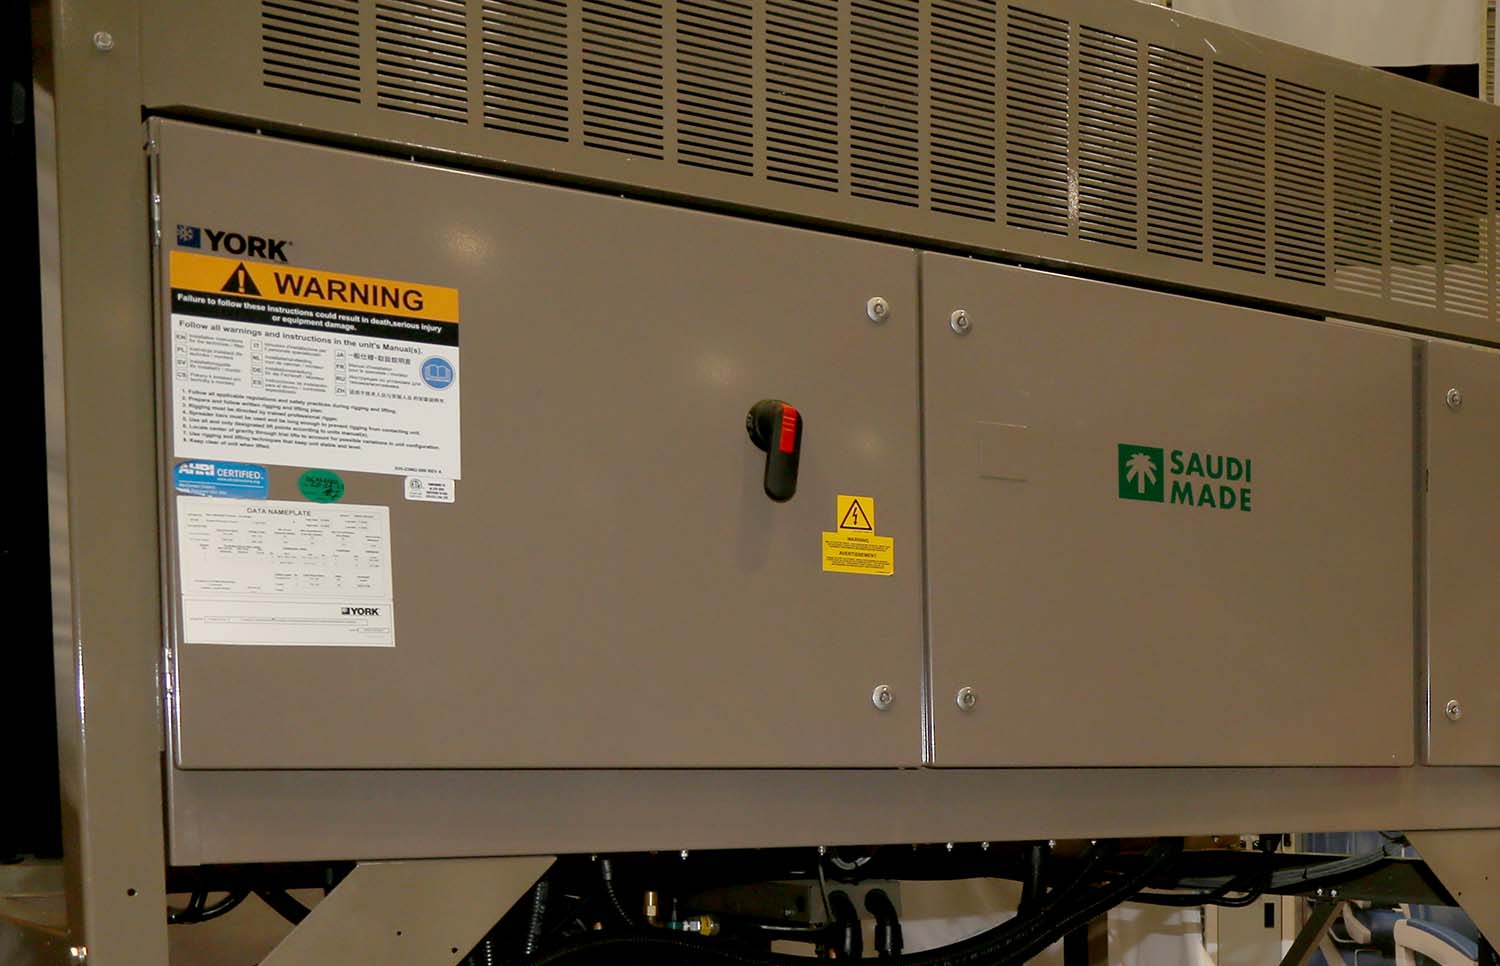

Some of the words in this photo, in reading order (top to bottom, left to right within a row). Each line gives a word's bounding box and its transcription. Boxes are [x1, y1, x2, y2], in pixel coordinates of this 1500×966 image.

[204, 229, 288, 262] YORK
[274, 272, 424, 311] WARNING
[177, 294, 206, 304] Failure
[207, 297, 216, 305] to
[217, 299, 242, 308] follow
[244, 302, 265, 311] these
[315, 311, 336, 320] could
[338, 313, 360, 322] result
[179, 320, 208, 330] Follow
[210, 322, 220, 331] all
[223, 326, 262, 337] warnings
[264, 329, 280, 338] and
[282, 331, 332, 345] instructions
[334, 337, 342, 345] in
[343, 339, 356, 347] the
[358, 342, 381, 350] unit's
[383, 343, 423, 355] Manual(s).
[282, 316, 323, 328] equipment
[325, 321, 357, 332] damage.
[179, 463, 215, 476] AHRI
[1170, 449, 1251, 483] SAUDI
[1170, 480, 1251, 512] MADE
[246, 507, 267, 515] DATA
[269, 509, 312, 517] NAMEPLATE
[350, 607, 380, 616] YORK
